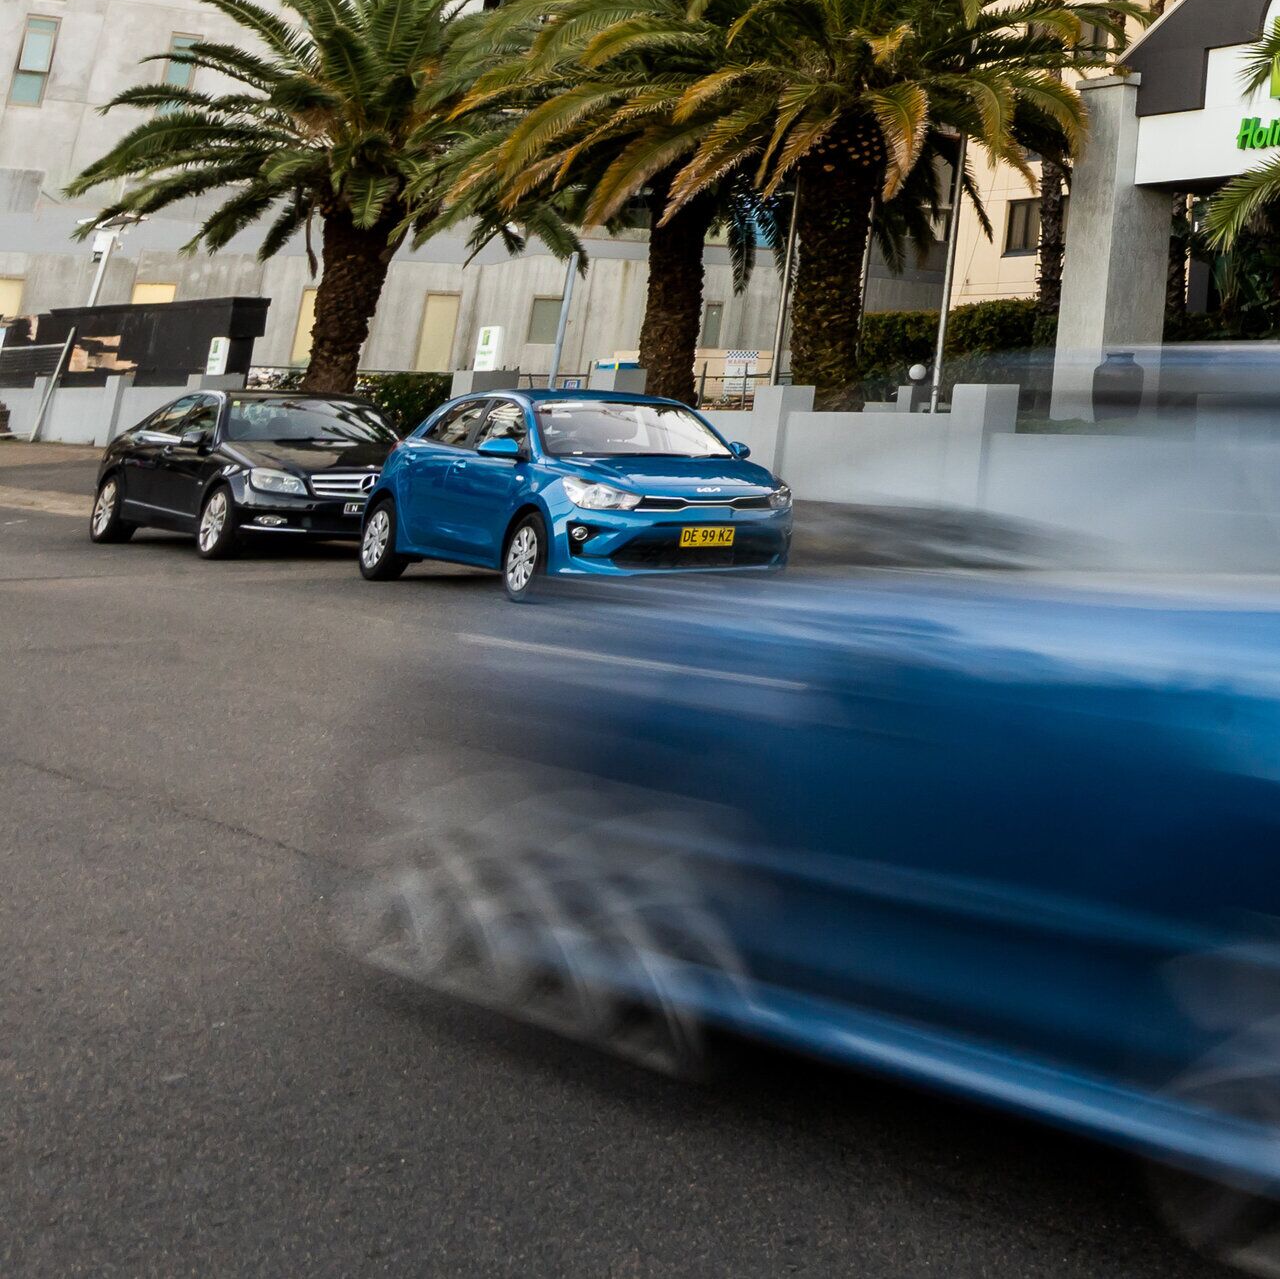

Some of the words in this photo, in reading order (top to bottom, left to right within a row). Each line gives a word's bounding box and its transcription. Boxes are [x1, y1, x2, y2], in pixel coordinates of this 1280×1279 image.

[683, 528, 699, 543] DE
[701, 529, 716, 542] 99
[718, 528, 733, 542] KZ
